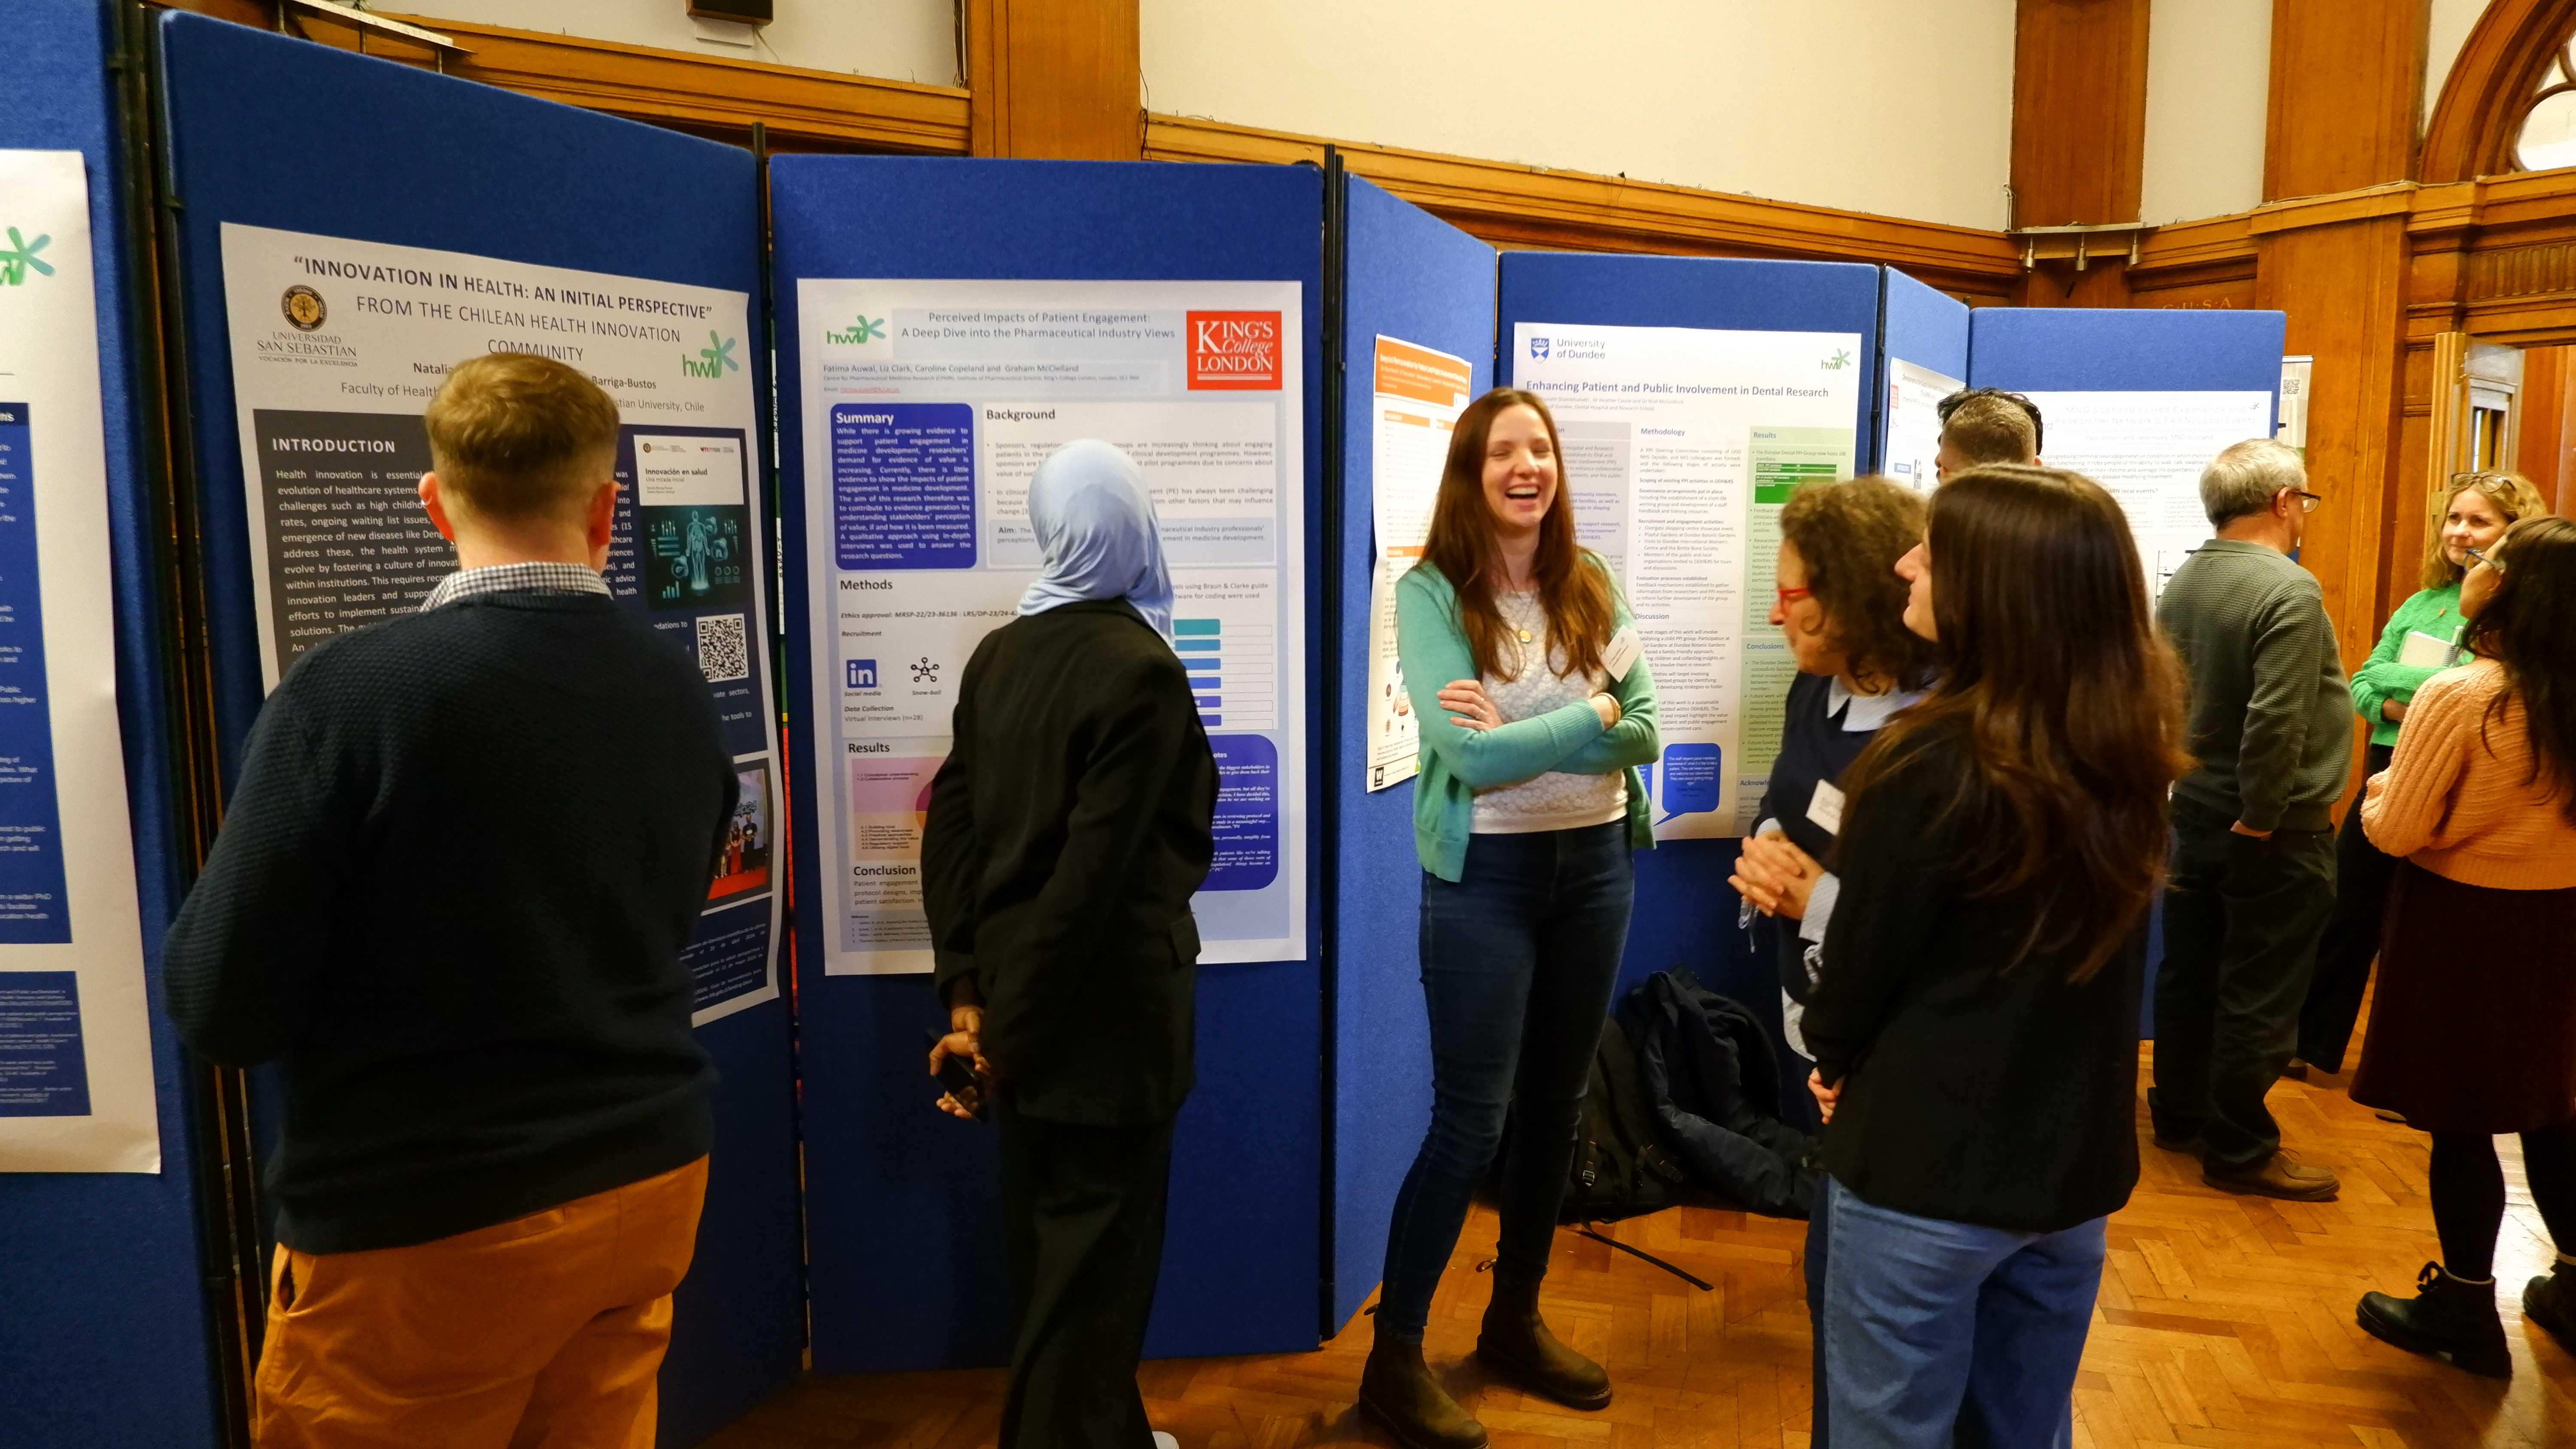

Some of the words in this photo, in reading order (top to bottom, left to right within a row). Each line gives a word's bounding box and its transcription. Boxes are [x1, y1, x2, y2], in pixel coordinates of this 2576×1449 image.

[439, 273, 457, 290] IN
[464, 276, 529, 299] HEALTH:
[535, 286, 555, 302] AN
[561, 289, 614, 309] INITIAL
[357, 296, 412, 315] FROM
[419, 302, 453, 320] THE
[459, 306, 525, 327] CHILEAN
[531, 315, 586, 334] HEALTH
[592, 321, 680, 343] INNOVATION
[929, 312, 980, 322] Perceived
[984, 312, 1025, 323] Impacts
[1028, 312, 1039, 322] of
[1042, 312, 1079, 323] Patient
[273, 331, 342, 343] UNIVERSIDAD
[902, 327, 909, 337] A
[913, 327, 940, 340] Deep
[944, 328, 966, 338] Dive
[970, 328, 990, 337] into
[994, 328, 1011, 337] the
[1015, 327, 1095, 338] Pharmaceutical
[1099, 328, 1141, 339] Industry
[1145, 329, 1175, 338] Views
[1196, 321, 1273, 354] KING'S
[257, 340, 283, 352] SAN
[287, 343, 356, 357] SEBASTIAN
[488, 340, 583, 361] COMMUNITY
[1222, 337, 1273, 359] College
[1557, 339, 1605, 349] University
[1557, 349, 1566, 358] of
[1569, 350, 1605, 359] Dundee
[851, 365, 877, 373] Auwal,
[891, 364, 913, 373] Clark,
[948, 365, 984, 373] Copeland
[1197, 356, 1273, 372] LONDON
[592, 376, 656, 389] Barriga-Bustos
[1525, 380, 1579, 393] Enhancing
[1583, 382, 1618, 392] Patient
[1621, 383, 1640, 392] and
[1643, 383, 1673, 393] Public
[1676, 384, 1737, 394] Involvement
[1741, 385, 1749, 395] in
[1752, 386, 1783, 396] Dental
[1786, 387, 1828, 397] Research
[341, 382, 384, 397] Faculty
[388, 384, 399, 395] of
[638, 399, 682, 412] University,
[684, 401, 705, 412] Chile
[836, 412, 894, 426] Summary
[987, 409, 1055, 422] Background
[1640, 428, 1685, 437] Methodology
[273, 438, 395, 453] INTRODUCTION
[276, 470, 307, 479] Health
[316, 470, 363, 479] innovation
[371, 471, 378, 479] is
[386, 470, 422, 479] essential
[278, 486, 321, 495] evolution
[324, 485, 333, 494] of
[335, 485, 382, 494] healthcare
[279, 501, 327, 512] challenges
[331, 500, 352, 510] such
[370, 501, 388, 512] high
[280, 518, 307, 527] rates,
[311, 517, 348, 527] ongoing
[351, 516, 383, 527] waiting
[387, 515, 399, 524] list
[404, 514, 431, 524] issues,
[282, 534, 333, 544] emergence
[336, 532, 345, 541] of
[368, 531, 404, 540] diseases
[406, 530, 420, 539] like
[283, 549, 319, 558] address
[326, 548, 353, 557] these,
[360, 547, 375, 555] the
[381, 545, 408, 555] health
[415, 546, 443, 555] system
[284, 564, 315, 574] evolve
[319, 564, 330, 574] by
[334, 562, 373, 572] fostering
[384, 561, 413, 570] culture
[416, 559, 425, 568] of
[840, 579, 893, 590] Methods
[850, 663, 874, 685] in
[848, 743, 890, 753] Results
[854, 865, 916, 876] Conclusion
